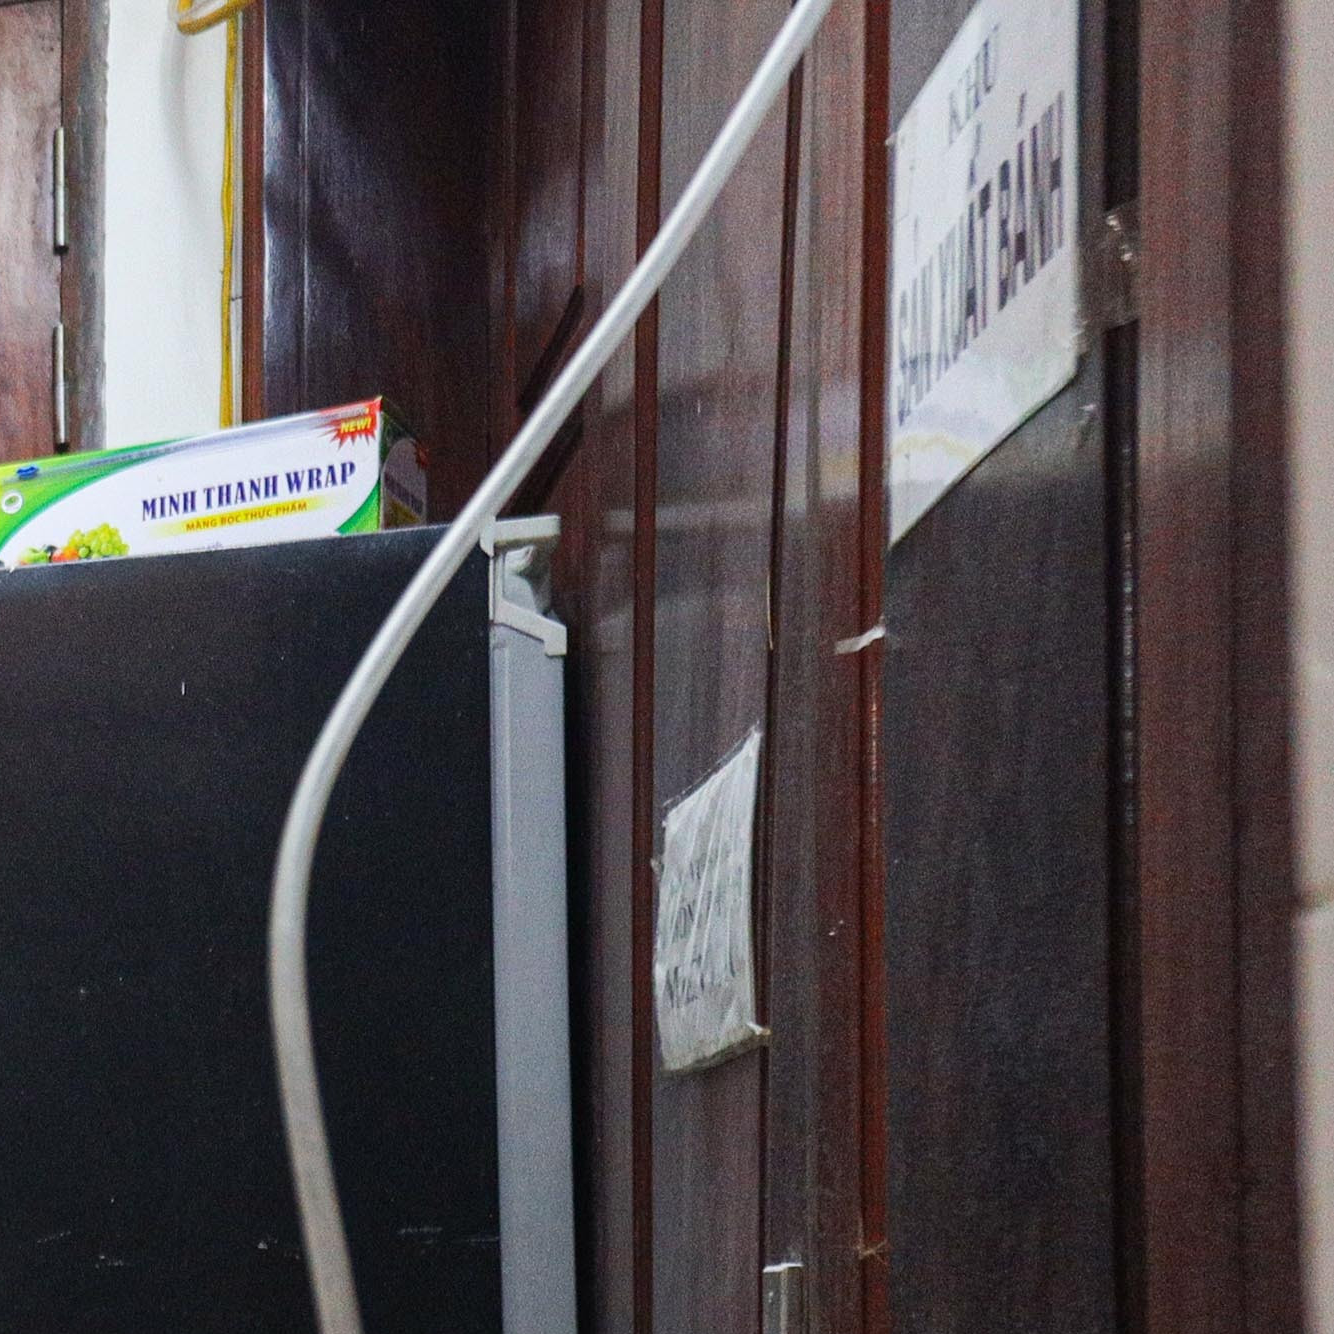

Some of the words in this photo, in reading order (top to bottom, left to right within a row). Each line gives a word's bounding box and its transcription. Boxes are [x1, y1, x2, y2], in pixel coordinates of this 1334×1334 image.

[340, 416, 372, 433] NEW!
[142, 487, 198, 521] MINH
[203, 474, 279, 510] THANH
[286, 461, 357, 493] WRAP
